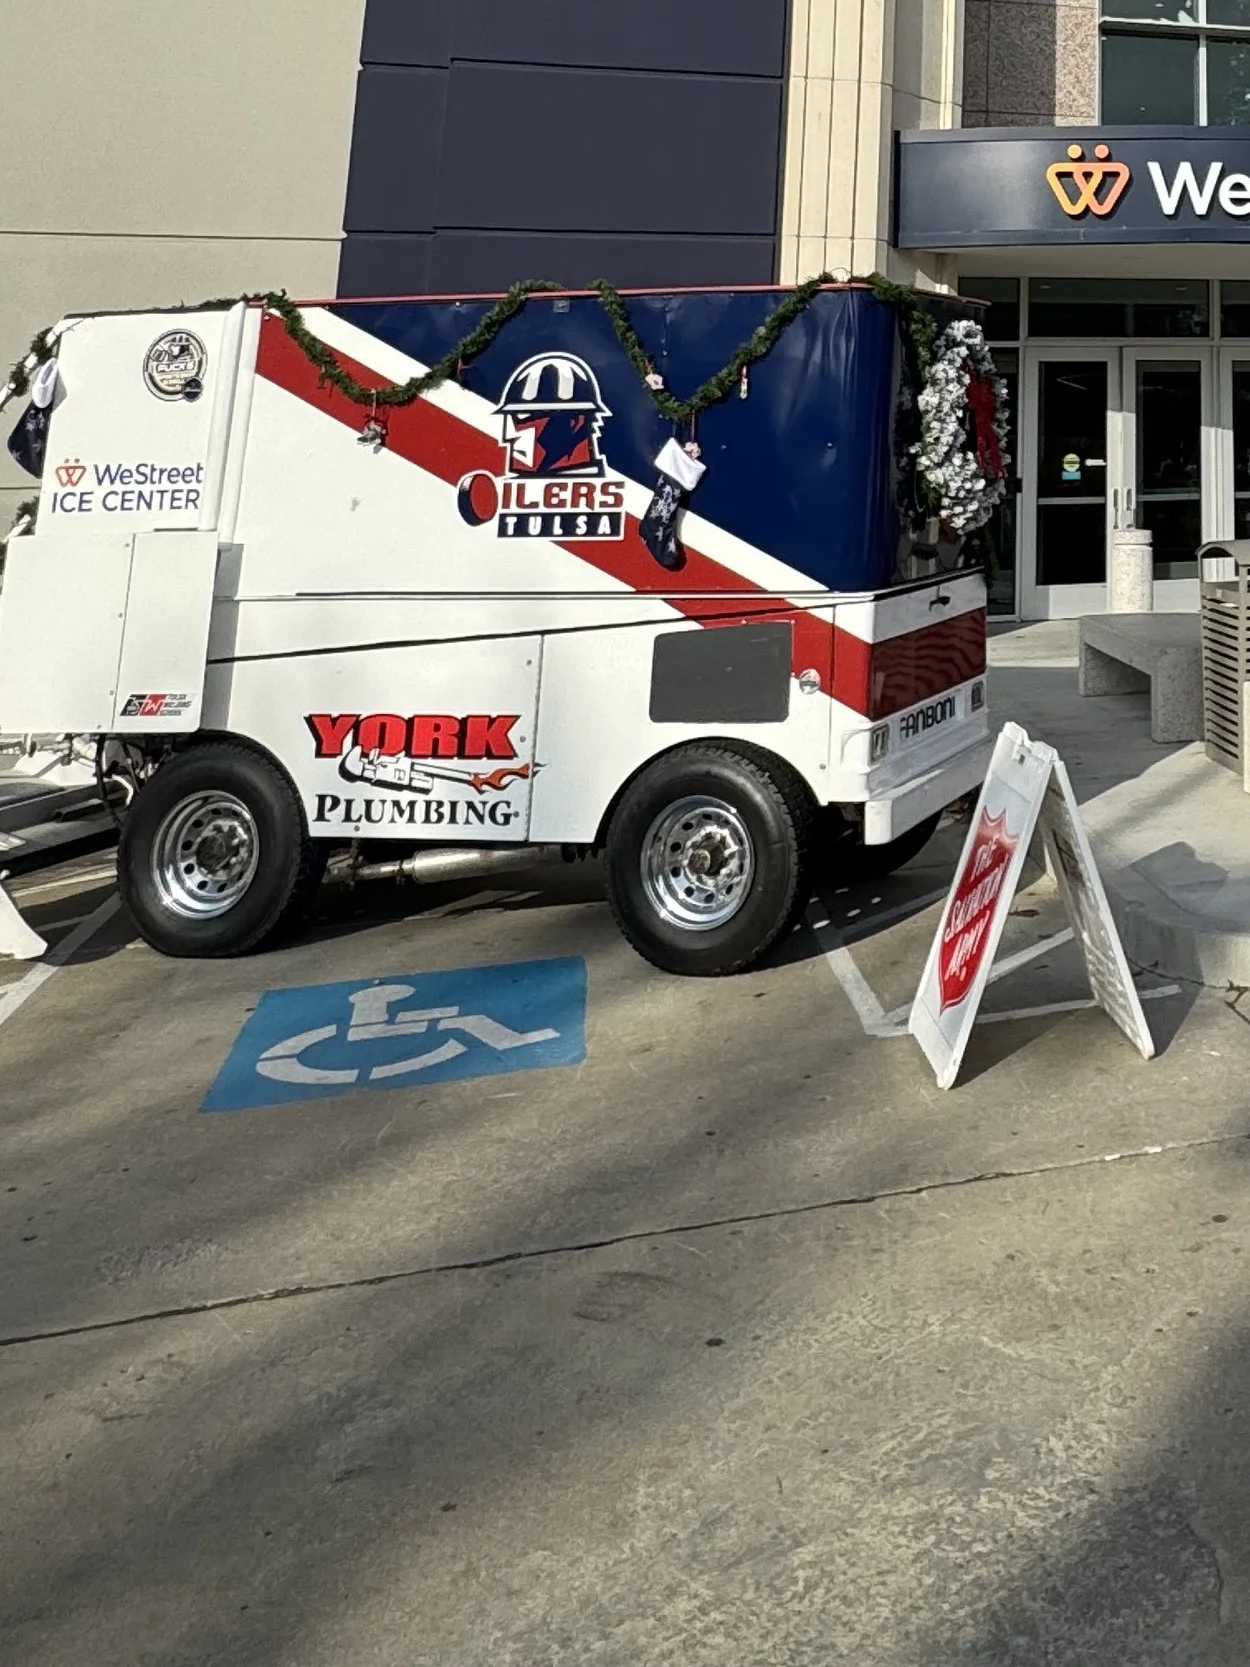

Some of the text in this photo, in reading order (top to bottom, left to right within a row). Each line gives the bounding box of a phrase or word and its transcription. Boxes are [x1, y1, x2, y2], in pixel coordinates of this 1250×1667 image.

[93, 462, 204, 486] WeStreet
[51, 489, 200, 513] ICE CENTER
[505, 516, 611, 536] TULSA
[303, 714, 522, 759] YORK
